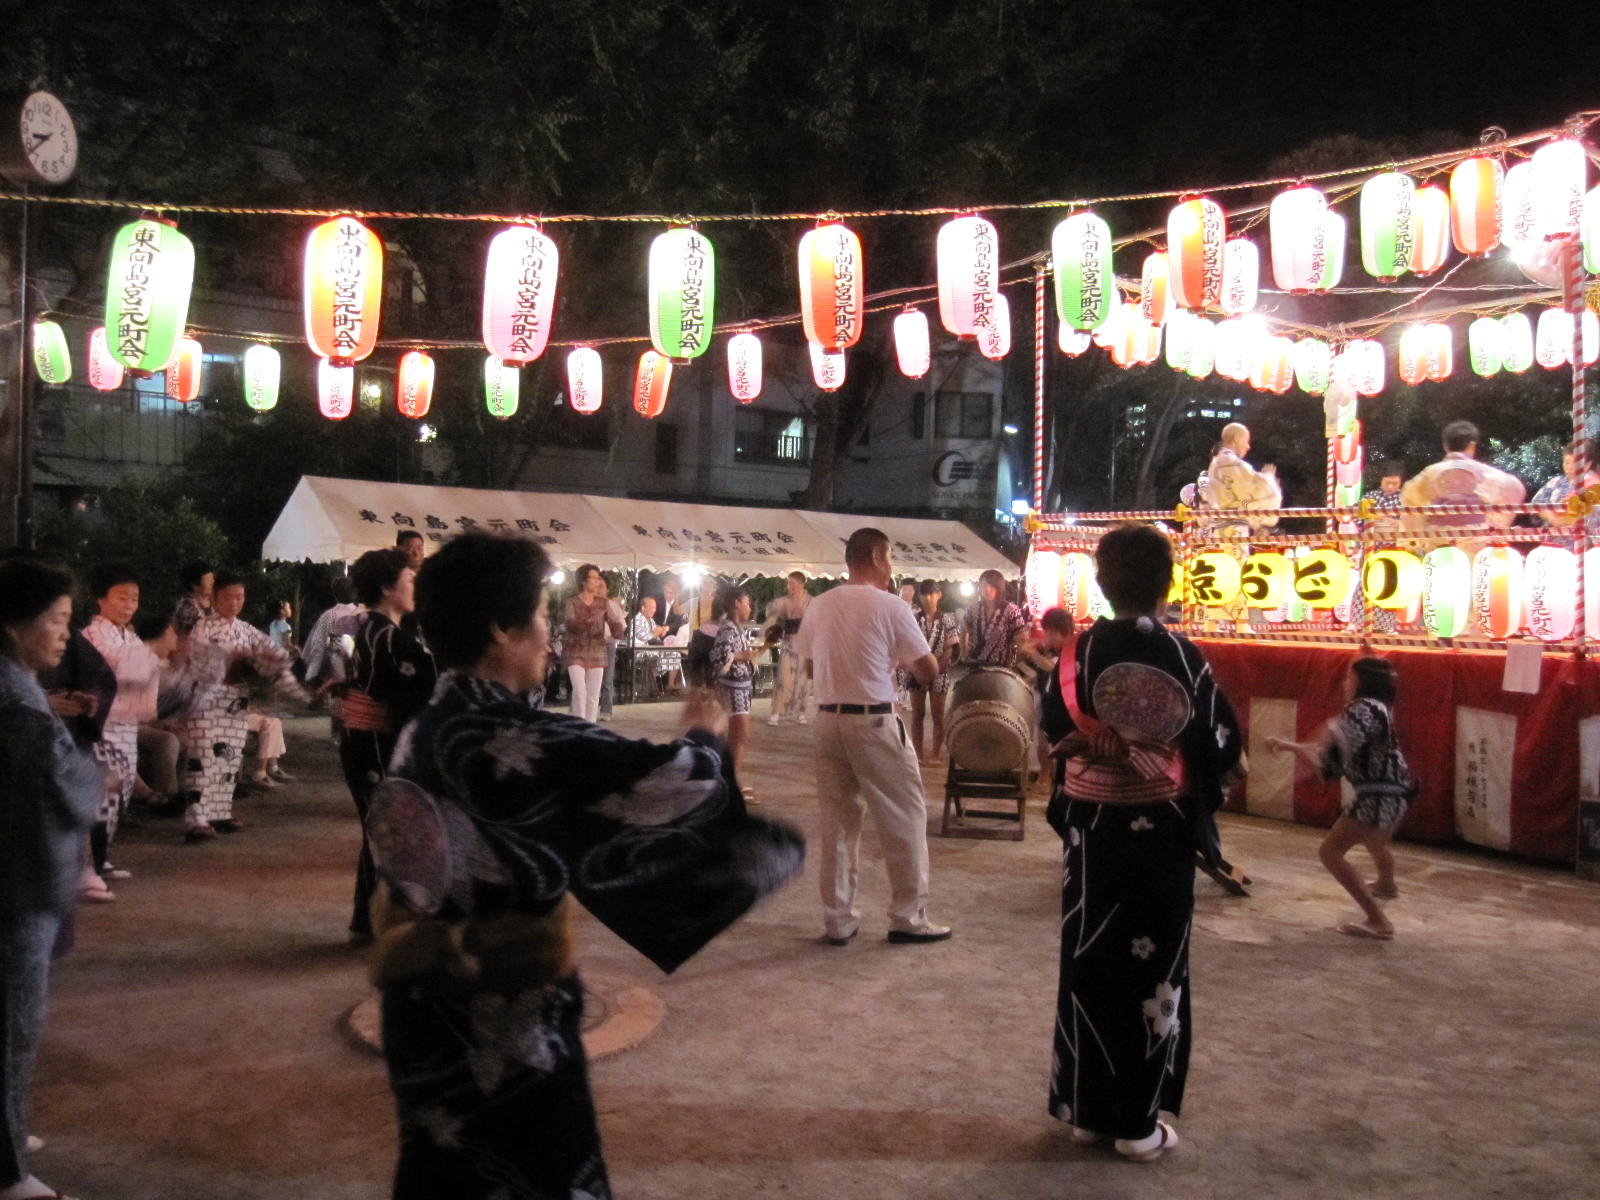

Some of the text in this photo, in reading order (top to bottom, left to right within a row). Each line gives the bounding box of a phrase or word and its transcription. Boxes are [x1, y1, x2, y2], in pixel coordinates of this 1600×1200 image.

[118, 227, 161, 359] 東向島宮元町会
[332, 223, 368, 350] 東向島宮元町会
[511, 235, 548, 354] 東向島宮元町会
[677, 236, 706, 351] 東向島宮元町会
[833, 233, 855, 343] 東向島宮元町会
[972, 222, 994, 328] 東向島宮元町会
[1078, 221, 1102, 323] 東向島宮元町会
[359, 509, 571, 532] 東向島宮元町会
